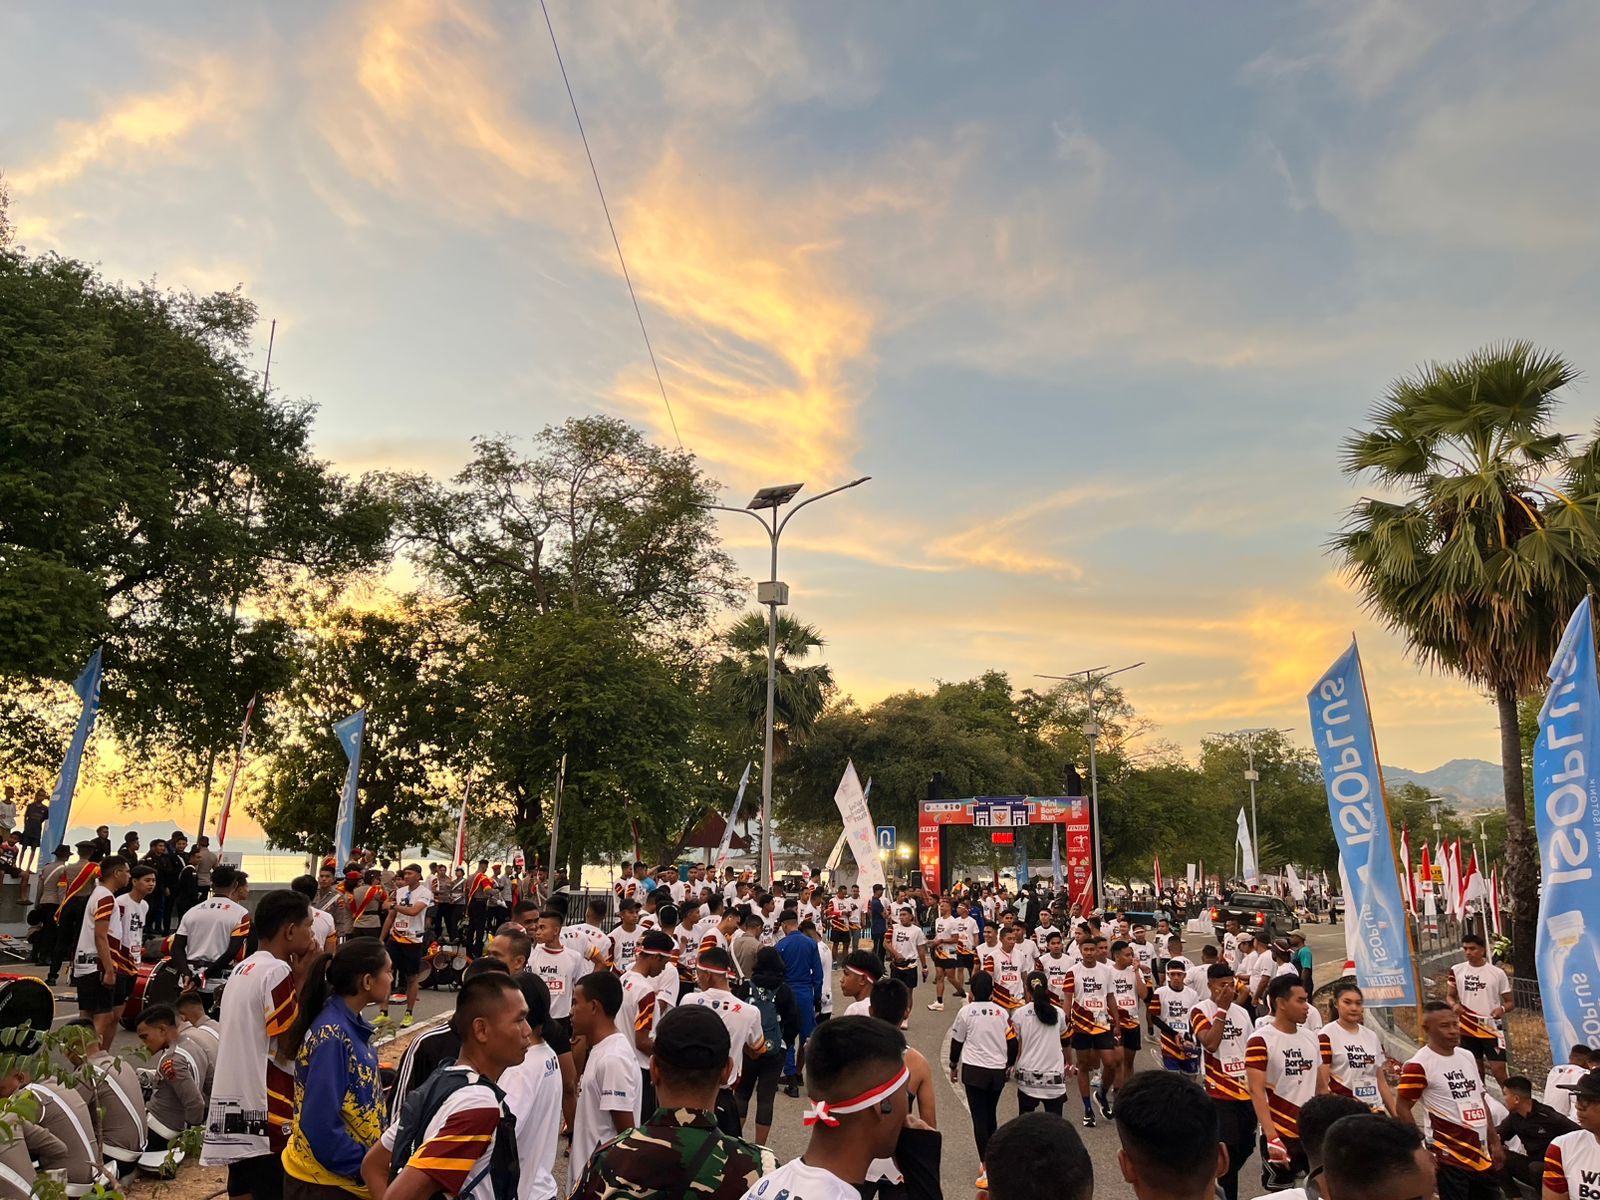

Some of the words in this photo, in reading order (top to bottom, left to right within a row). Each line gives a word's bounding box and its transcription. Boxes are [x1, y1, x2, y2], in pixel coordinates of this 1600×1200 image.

[1040, 799, 1057, 807] Wini
[1041, 806, 1067, 815] Border
[540, 965, 558, 974] Wini
[1083, 982, 1102, 990] Border
[1464, 981, 1487, 989] Border
[1282, 1048, 1302, 1058] Wini
[1344, 1044, 1364, 1053] Wini
[1347, 1052, 1376, 1062] Border
[1285, 1057, 1314, 1068] Border
[1349, 1061, 1367, 1069] Run
[1285, 1067, 1303, 1076] Run
[1443, 1070, 1465, 1081] Wini
[1448, 1079, 1476, 1091] Border
[1452, 1090, 1471, 1100] Run
